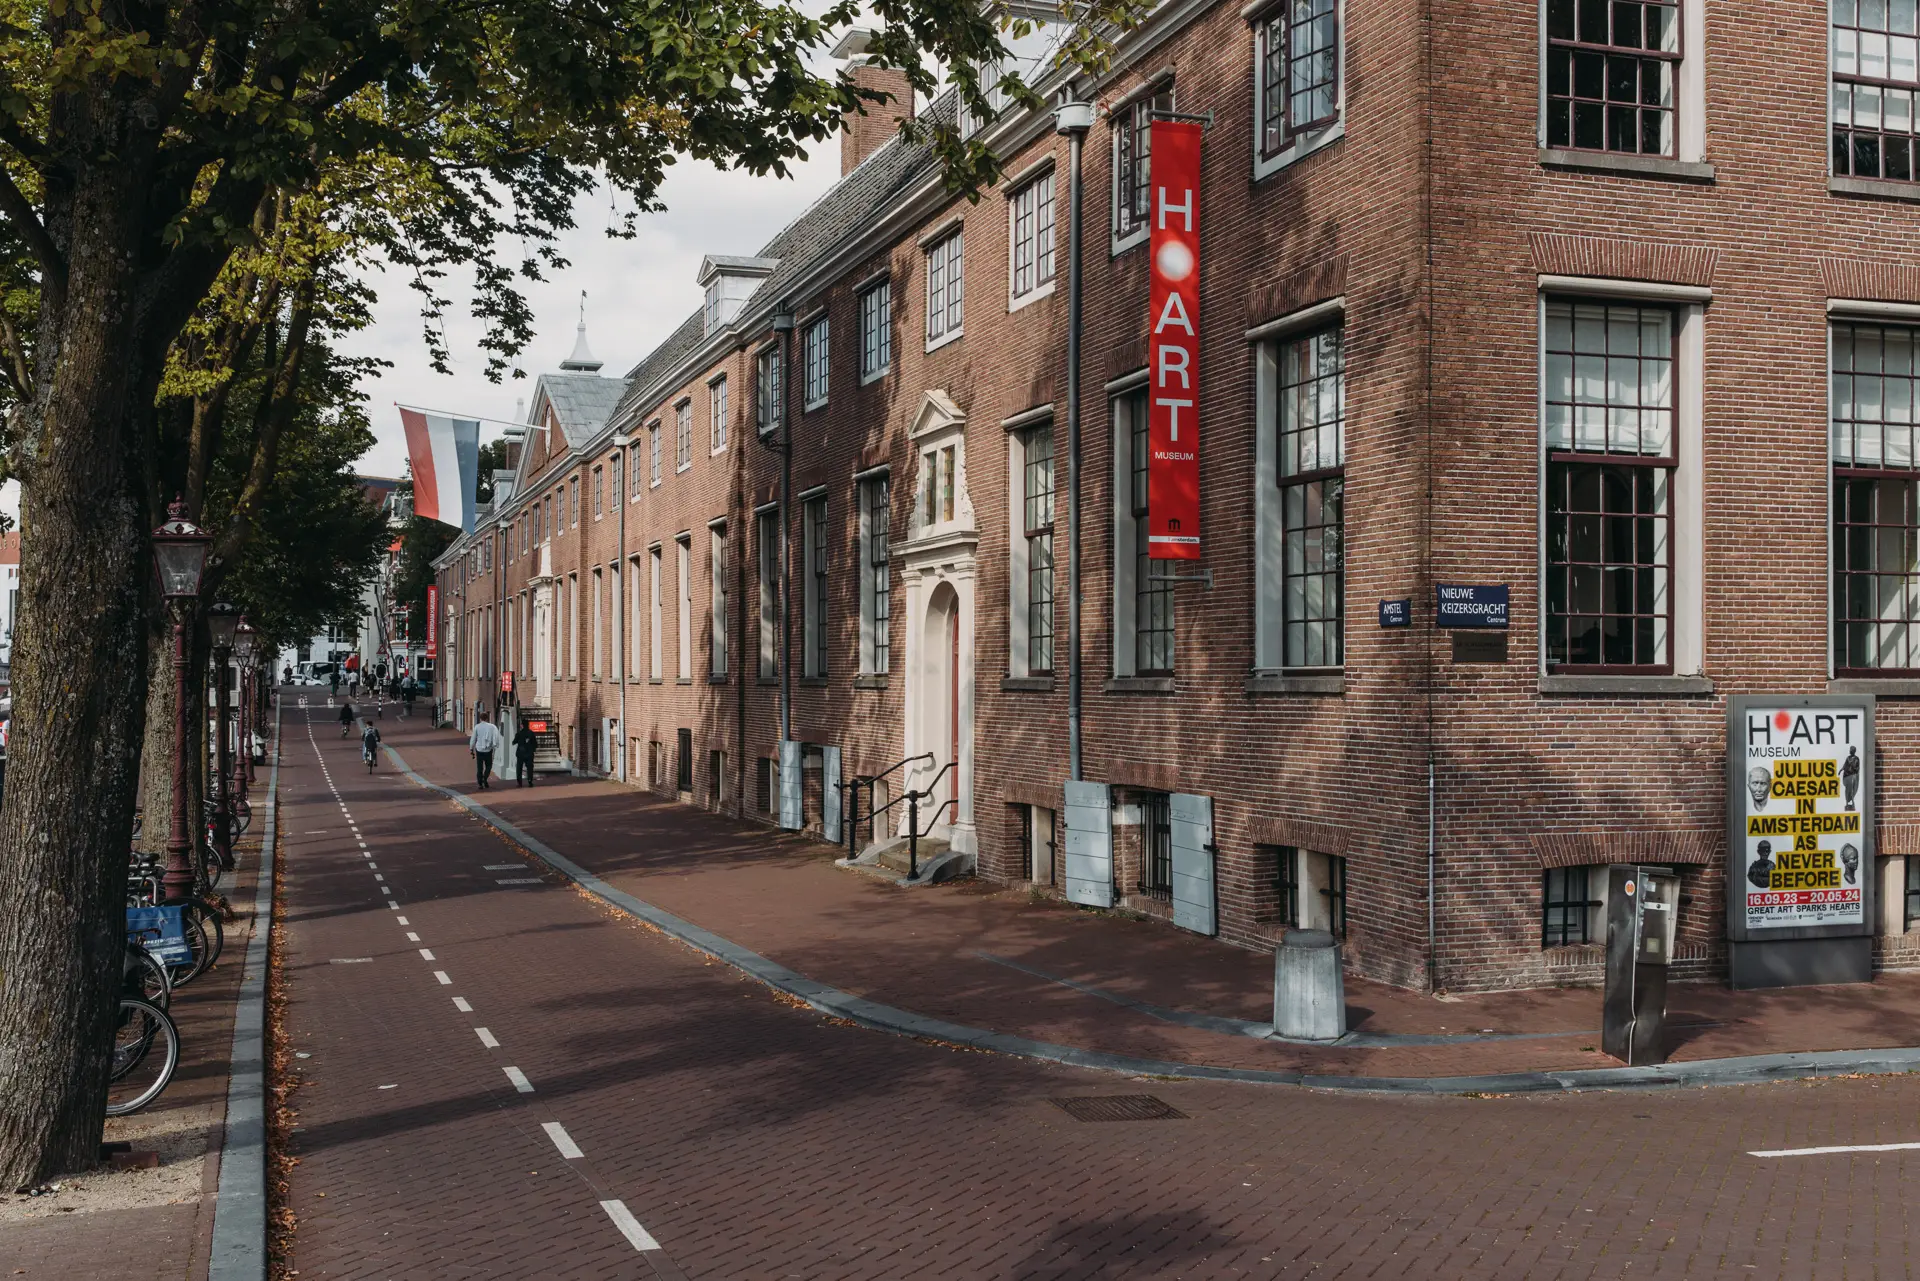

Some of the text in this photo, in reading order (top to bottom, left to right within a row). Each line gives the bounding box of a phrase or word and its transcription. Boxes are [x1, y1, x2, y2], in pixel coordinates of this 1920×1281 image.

[1155, 451, 1194, 461] MUSEUM
[1441, 588, 1474, 599] NIEUWE
[1383, 603, 1403, 614] AMSTEL
[1441, 602, 1506, 615] KEIZERSGRACHT
[1486, 615, 1507, 623] Centrum
[1748, 746, 1801, 758] MUSEUM
[1775, 761, 1835, 778] JULIUS
[1772, 780, 1839, 797] CAESAR
[1797, 799, 1814, 814] IN
[1749, 815, 1859, 834] AMSTERDAM
[1794, 835, 1817, 851] AS
[1777, 852, 1834, 870] NEVER
[1771, 870, 1840, 888] BEFORE
[1748, 893, 1798, 905] 16.09.23
[1810, 890, 1859, 903] 20.05.24
[1747, 902, 1861, 915] GREAT ART SPARKS HEARTS
